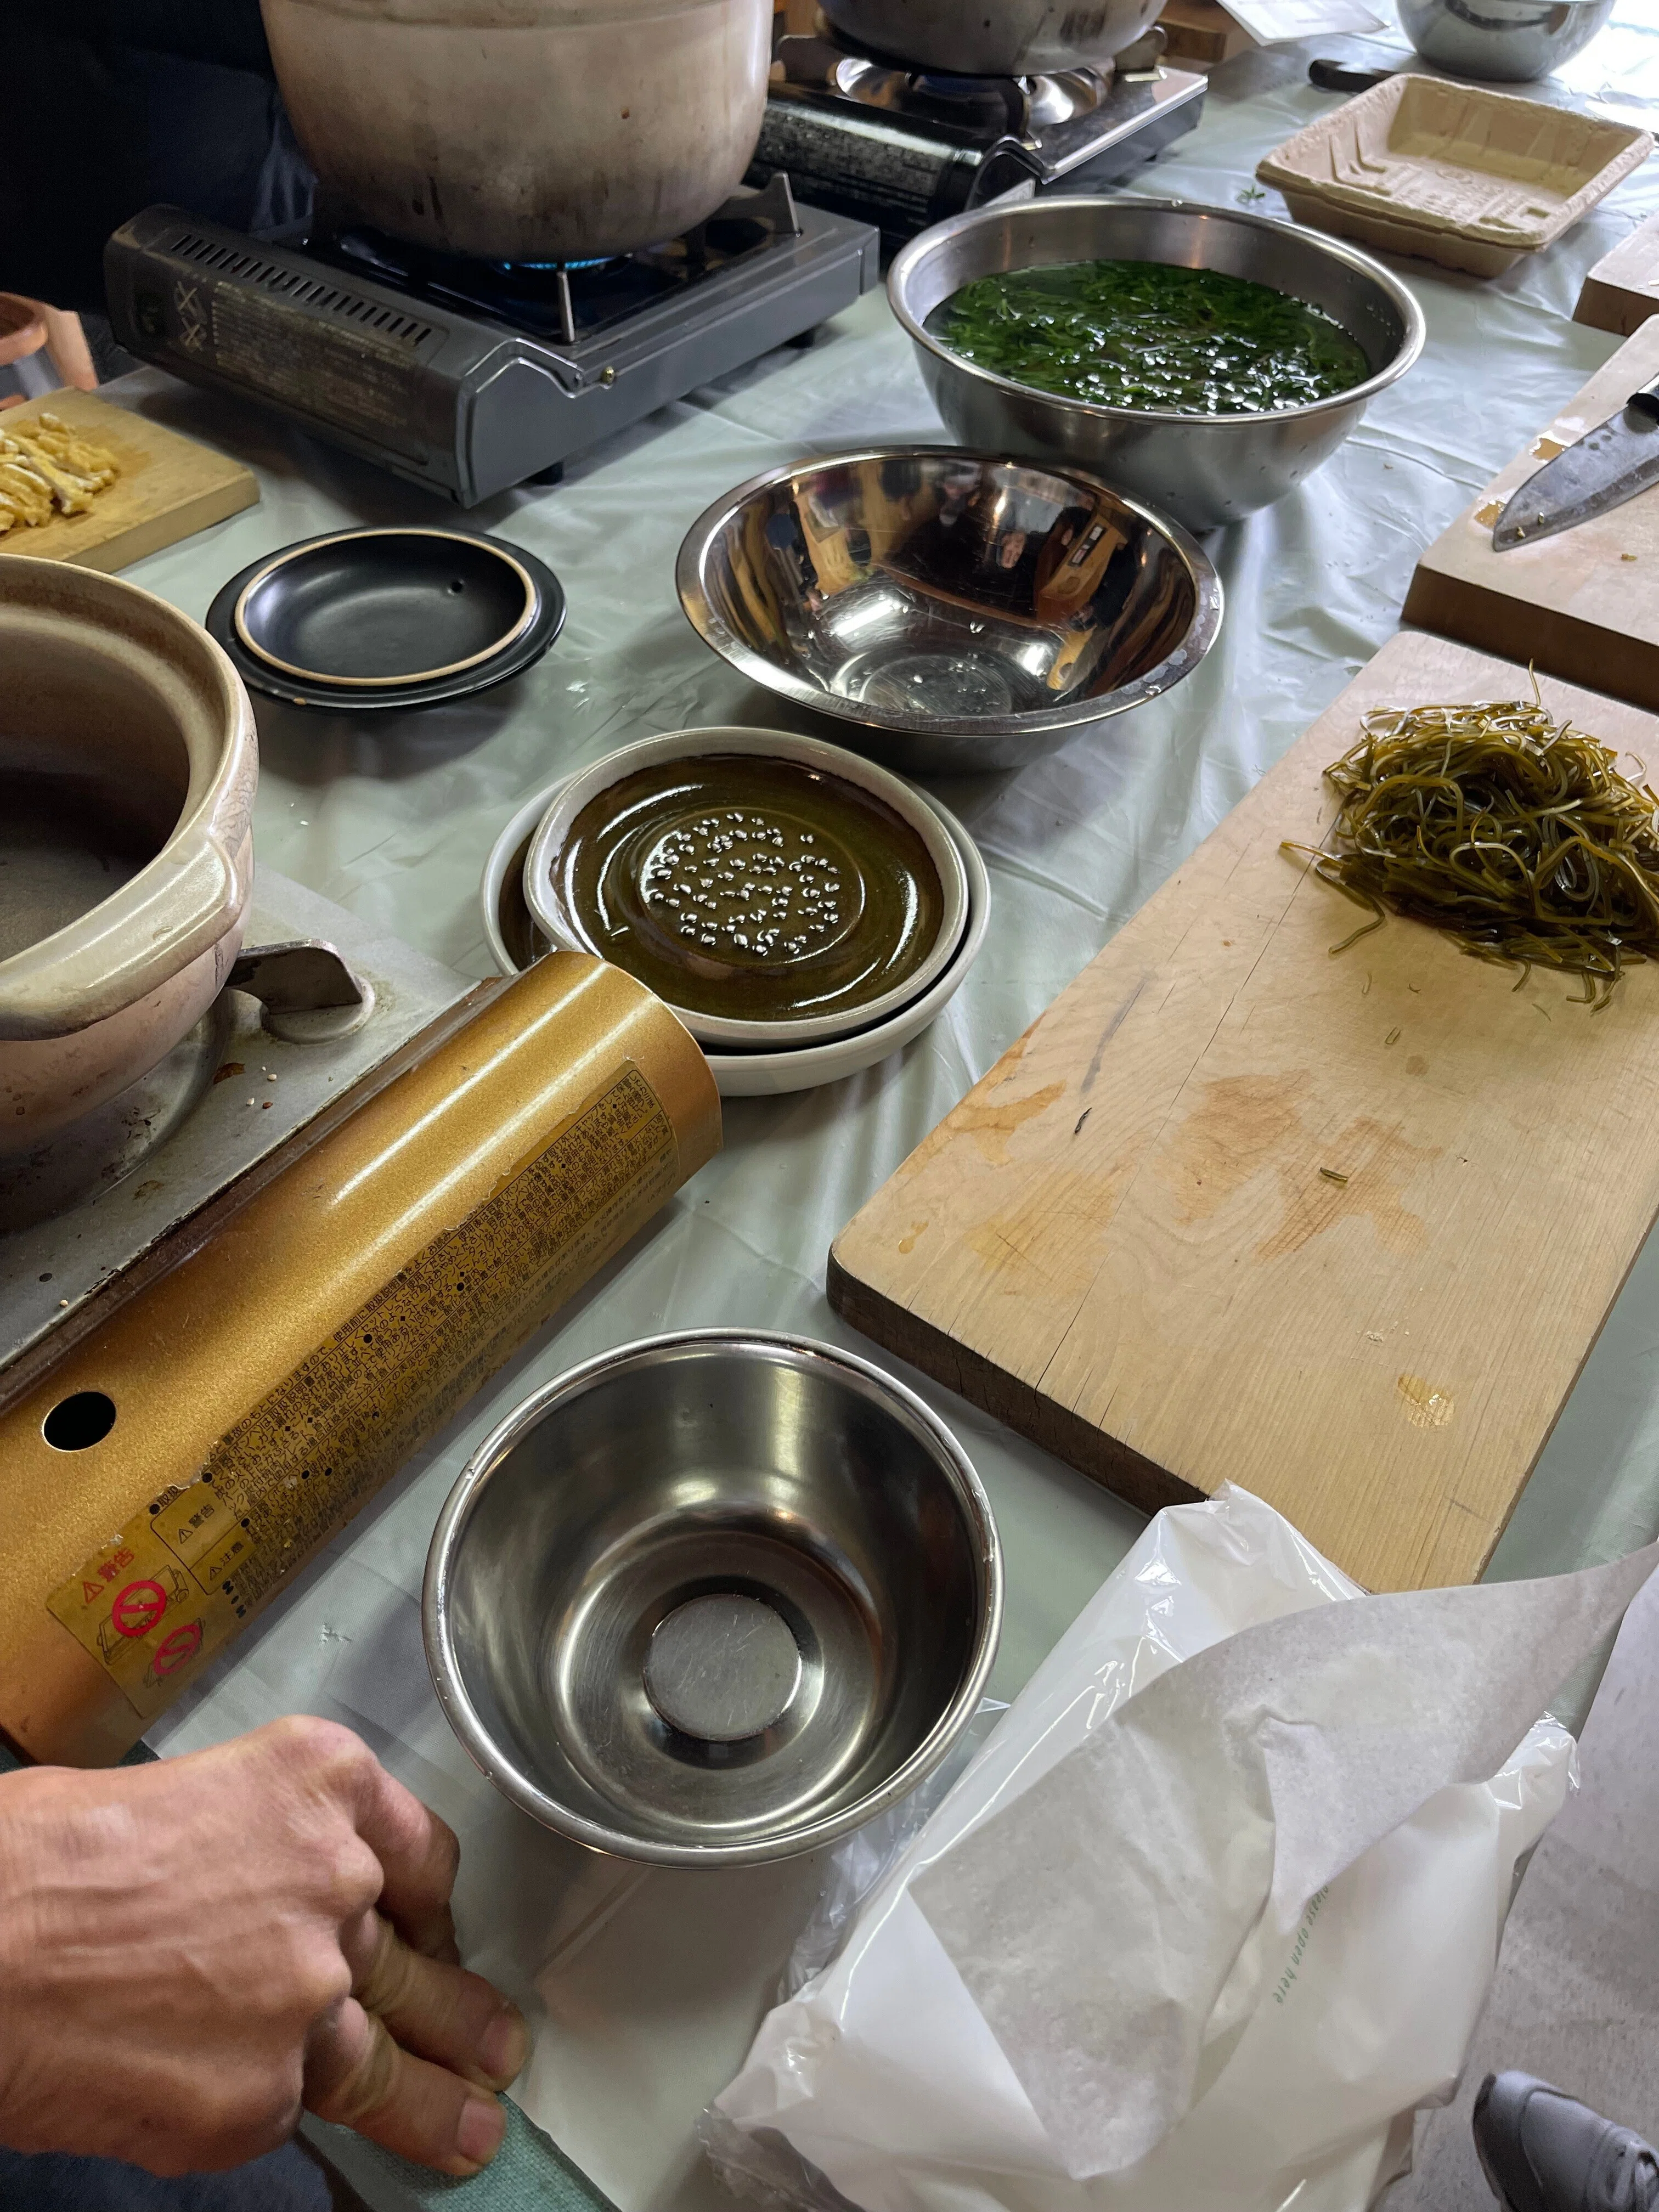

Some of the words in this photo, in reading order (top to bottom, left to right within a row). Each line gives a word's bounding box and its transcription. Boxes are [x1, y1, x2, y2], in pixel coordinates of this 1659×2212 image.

[190, 1504, 215, 1530] 警告
[98, 1547, 135, 1582] 警告
[219, 1542, 245, 1566] 注意
[1291, 1928, 1309, 1965] open
[1272, 1967, 1297, 2004] here
